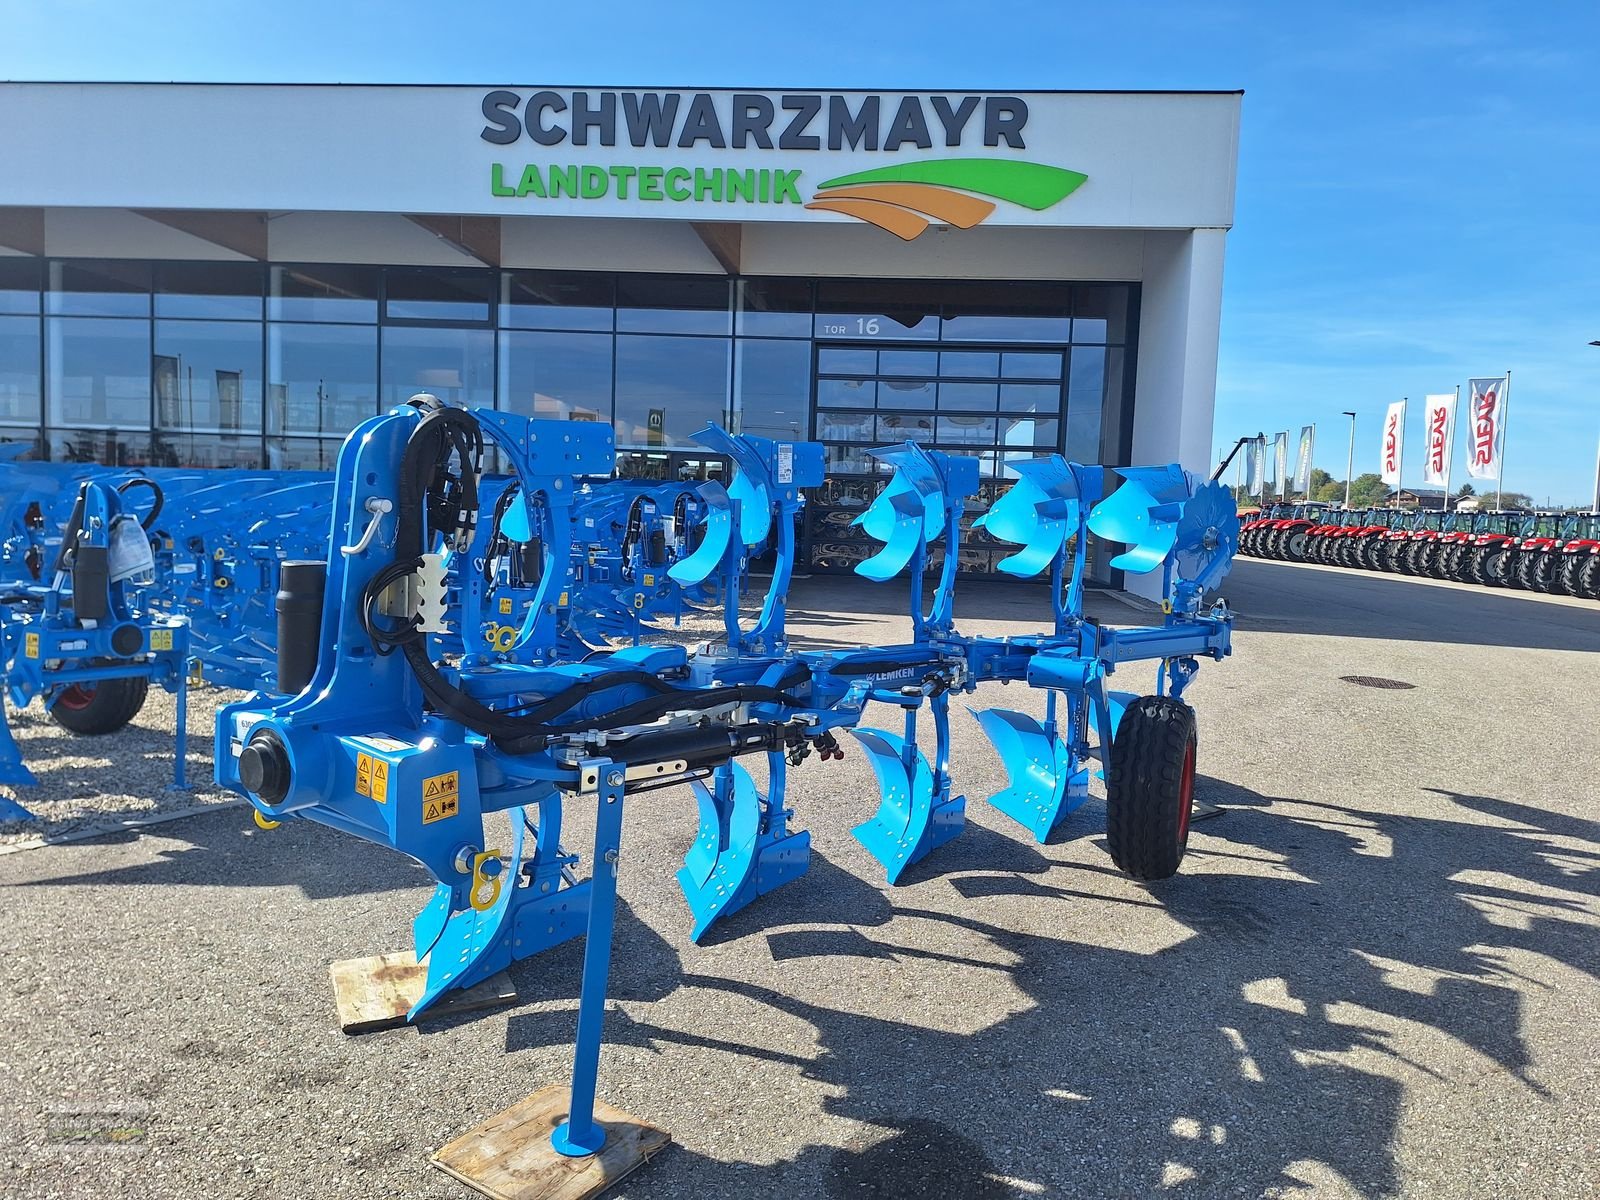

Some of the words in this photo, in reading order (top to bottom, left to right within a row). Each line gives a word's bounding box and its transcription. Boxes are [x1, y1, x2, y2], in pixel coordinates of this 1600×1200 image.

[480, 90, 1029, 152] SCHWARZMAYR
[491, 163, 803, 204] LANDTECHNIK
[824, 325, 846, 334] TOR
[857, 318, 880, 335] 16
[876, 668, 914, 681] LEMKEN
